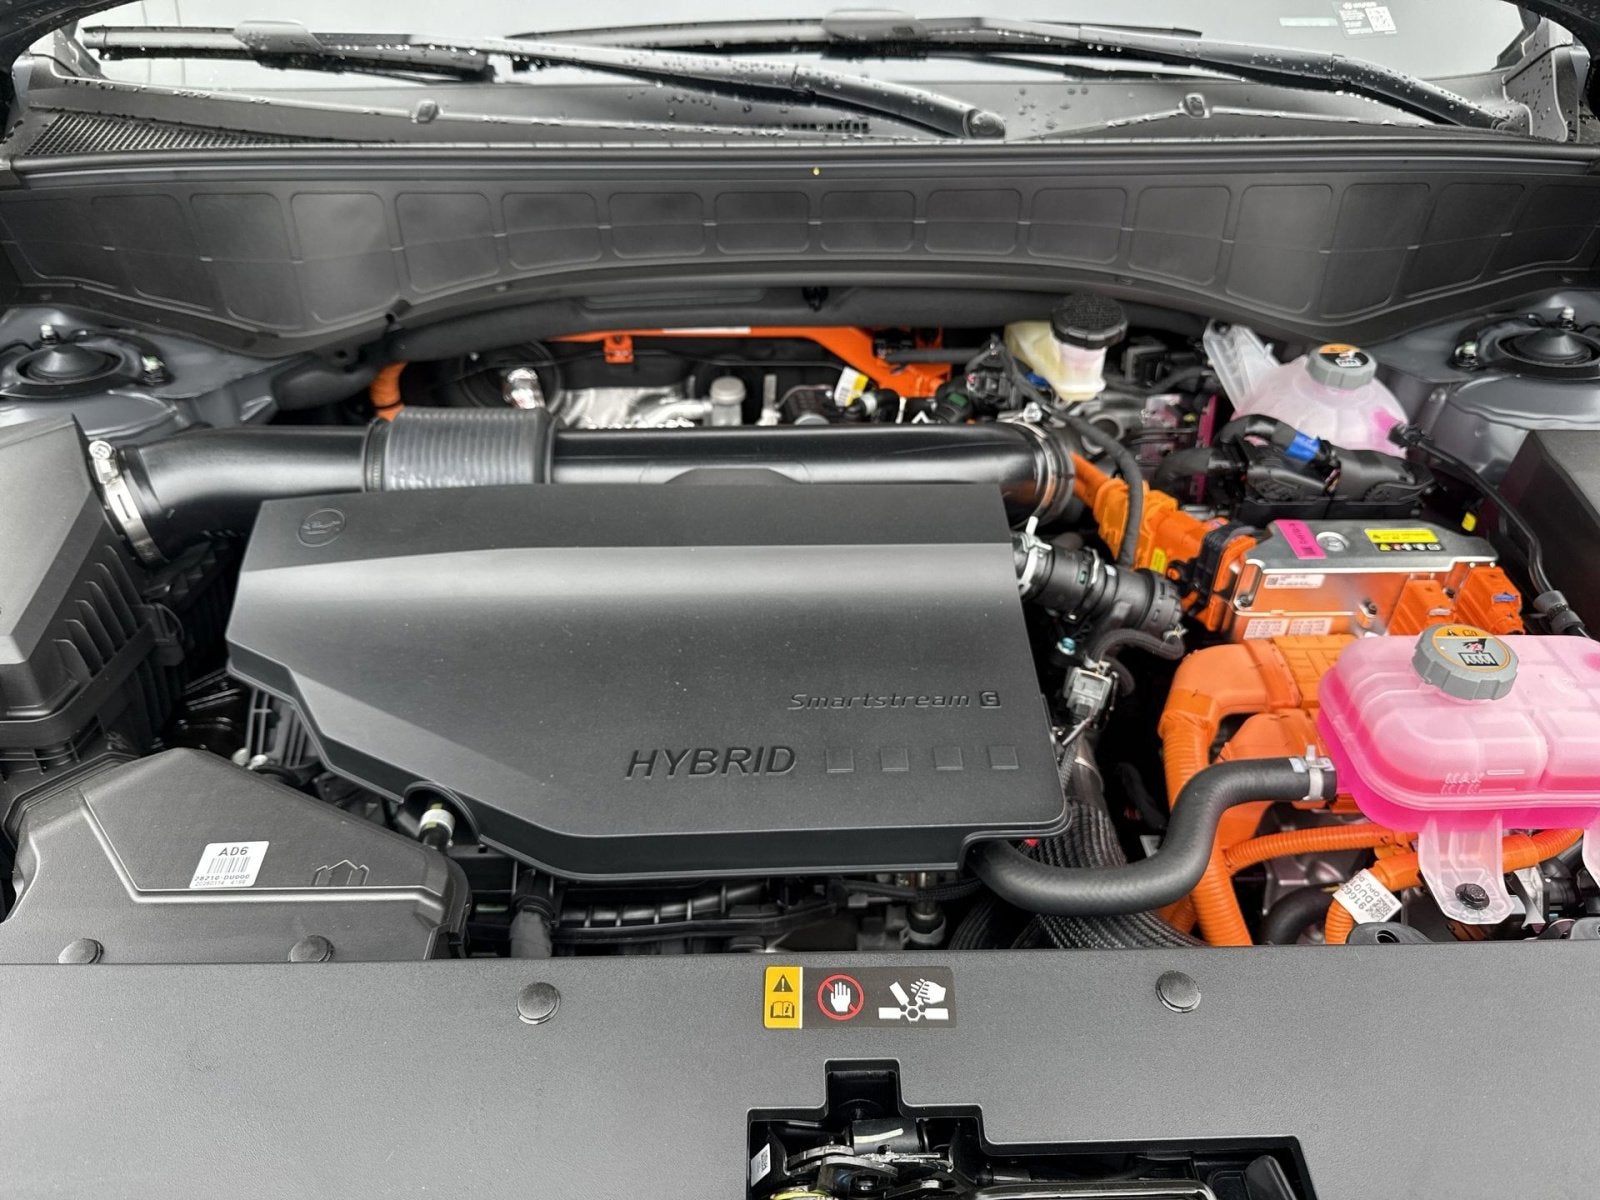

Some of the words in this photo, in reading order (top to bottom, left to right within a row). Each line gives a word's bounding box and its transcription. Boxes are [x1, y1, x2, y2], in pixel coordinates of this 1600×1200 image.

[787, 693, 971, 711] Smartstream
[978, 690, 1002, 710] G
[624, 745, 798, 780] HYBRID
[218, 846, 249, 856] AD6
